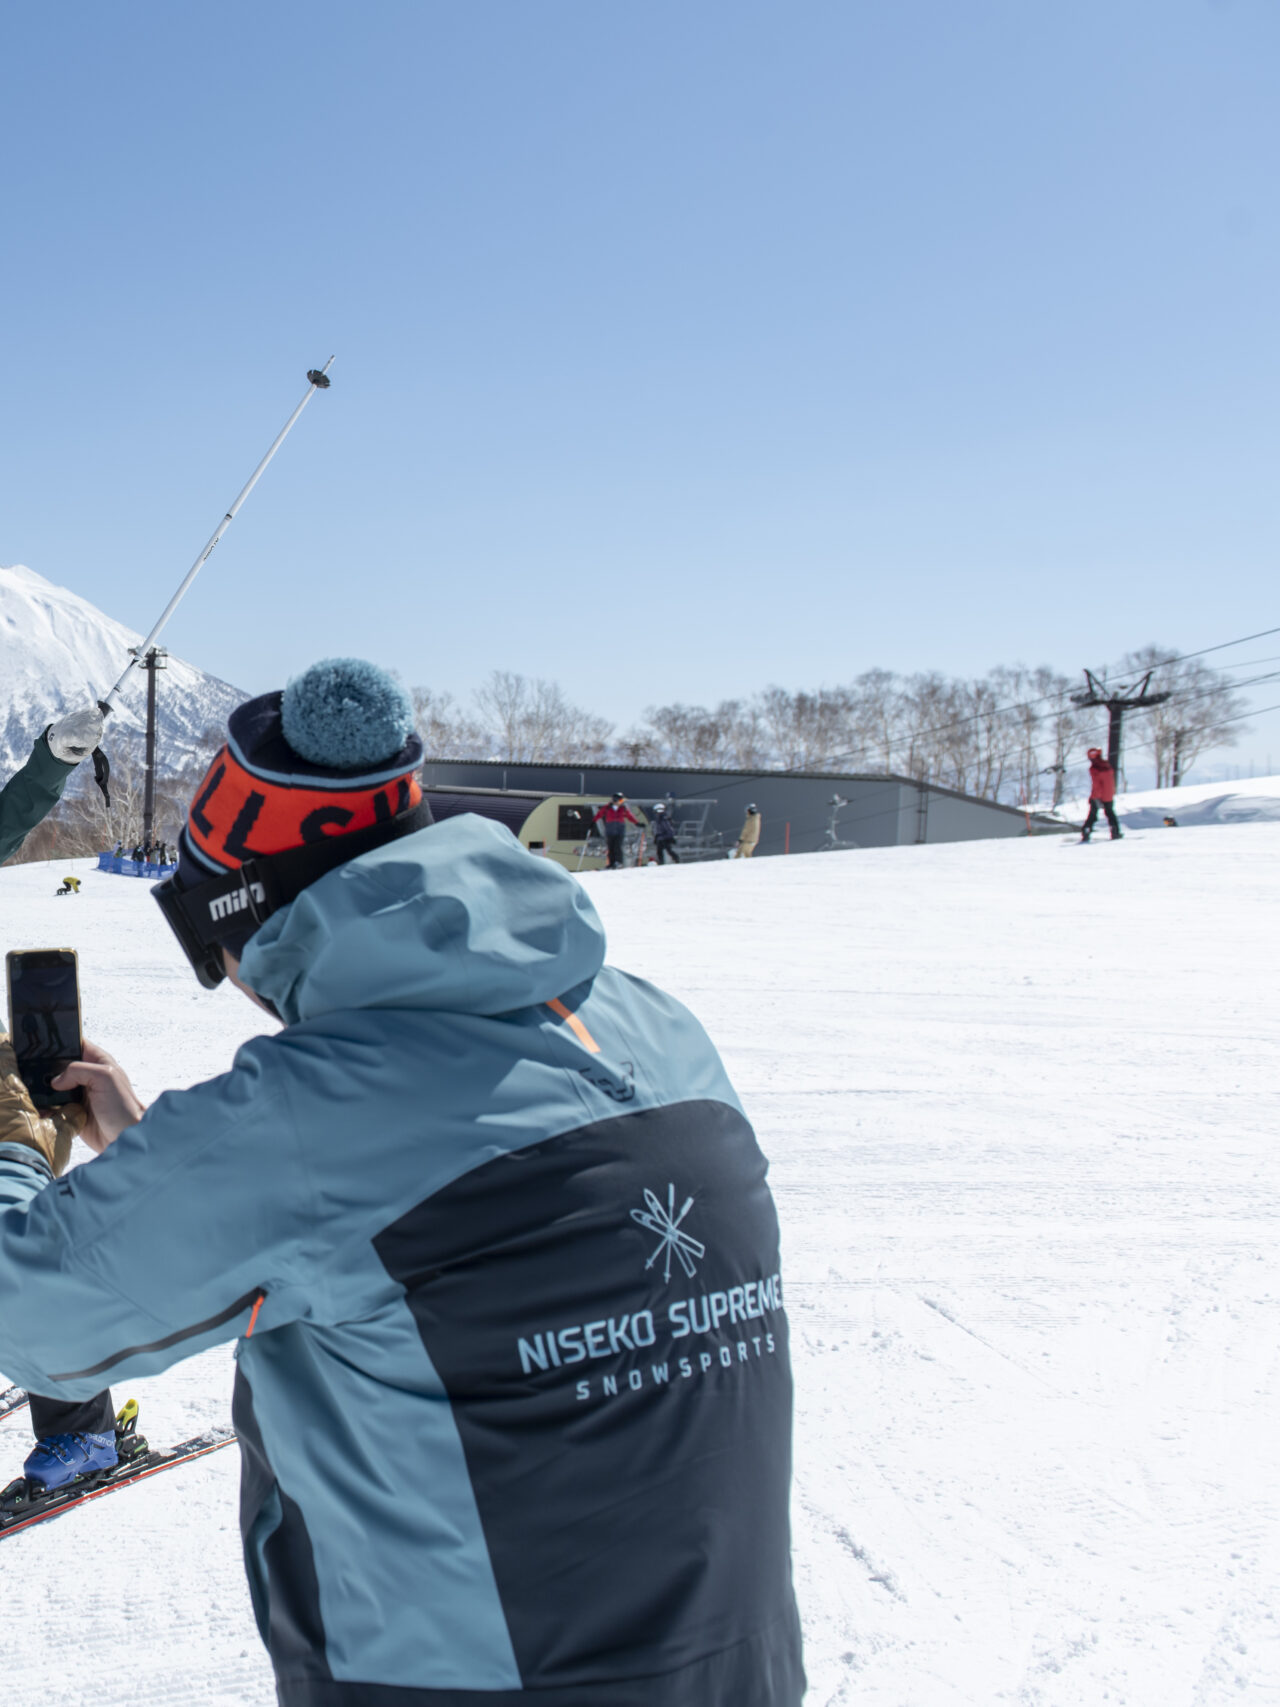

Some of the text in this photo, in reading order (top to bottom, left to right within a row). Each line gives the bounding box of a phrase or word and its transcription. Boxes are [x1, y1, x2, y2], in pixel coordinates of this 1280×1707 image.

[517, 1273, 783, 1375] NISEKO SUPREME
[575, 1332, 775, 1400] SNOWSPORTS
